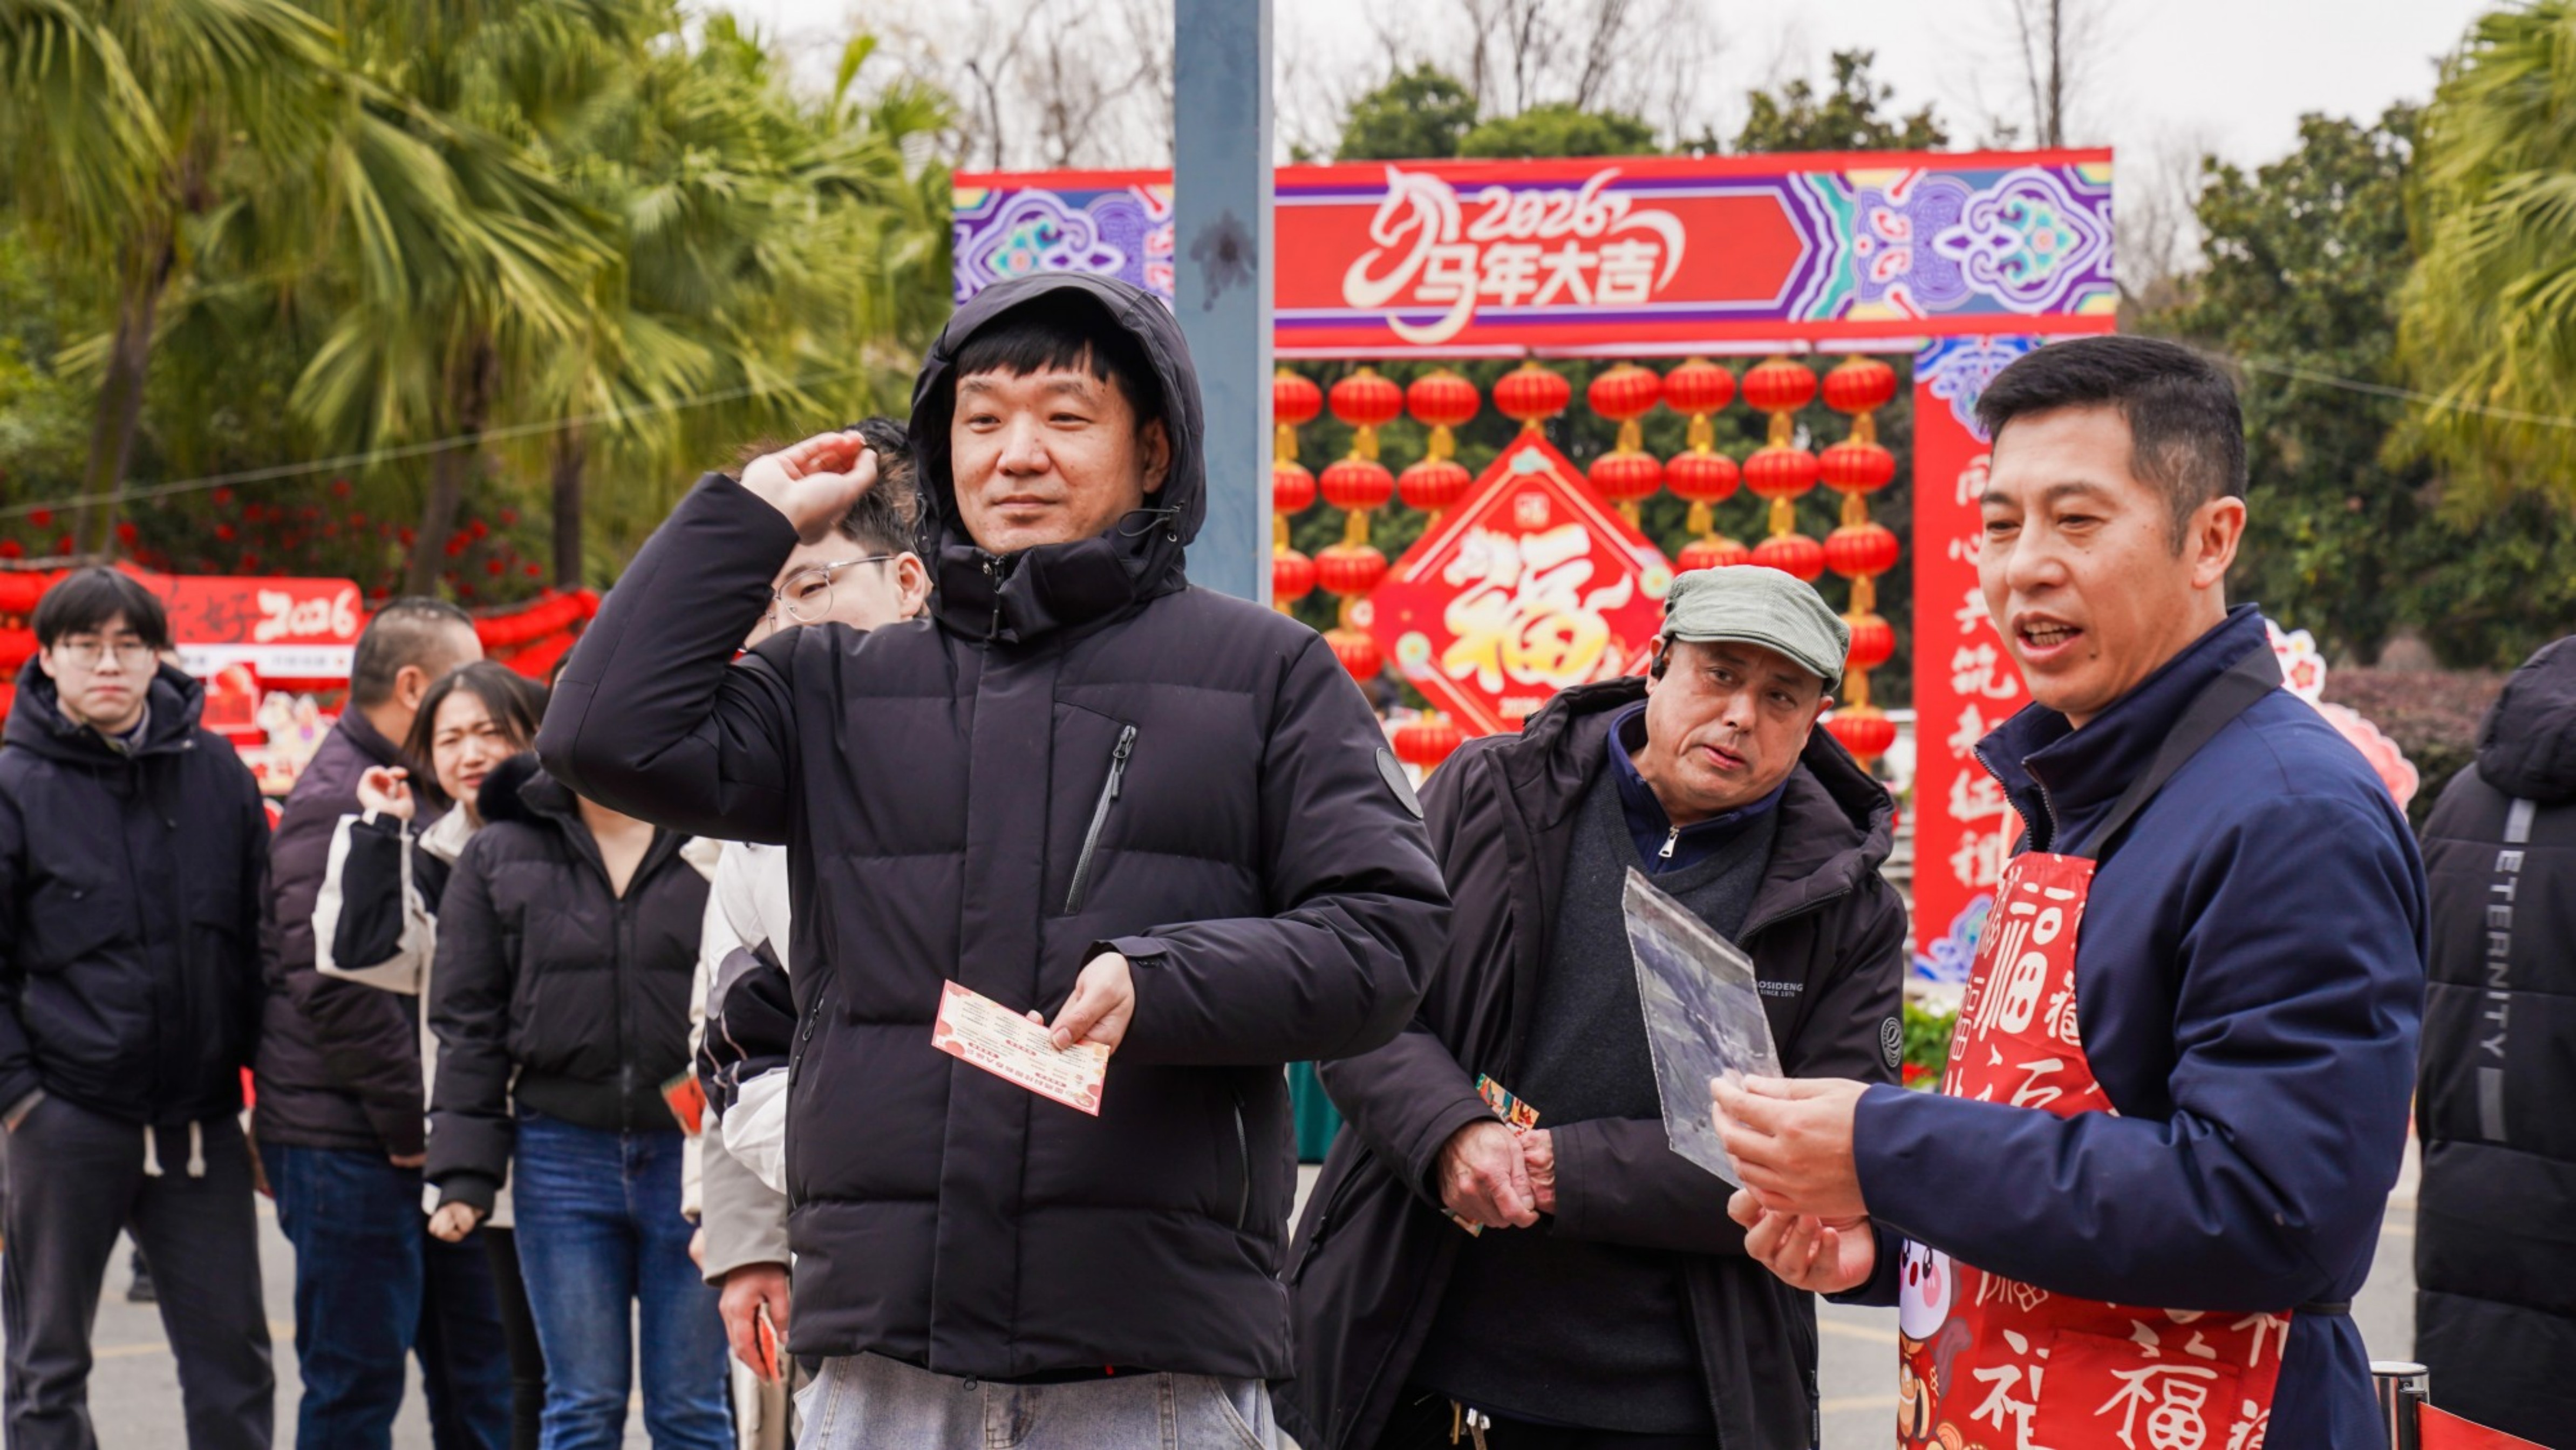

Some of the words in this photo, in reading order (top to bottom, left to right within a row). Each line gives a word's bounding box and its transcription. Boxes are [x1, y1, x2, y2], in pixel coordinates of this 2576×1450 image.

[1466, 168, 1621, 241] 2026
[1409, 238, 1662, 310] 马年大吉
[254, 587, 358, 643] 2026
[1442, 522, 1633, 694] 福
[1756, 981, 1803, 992] OSIDENG
[1972, 882, 2076, 1042] 福
[2479, 850, 2525, 1059] ETERNITY
